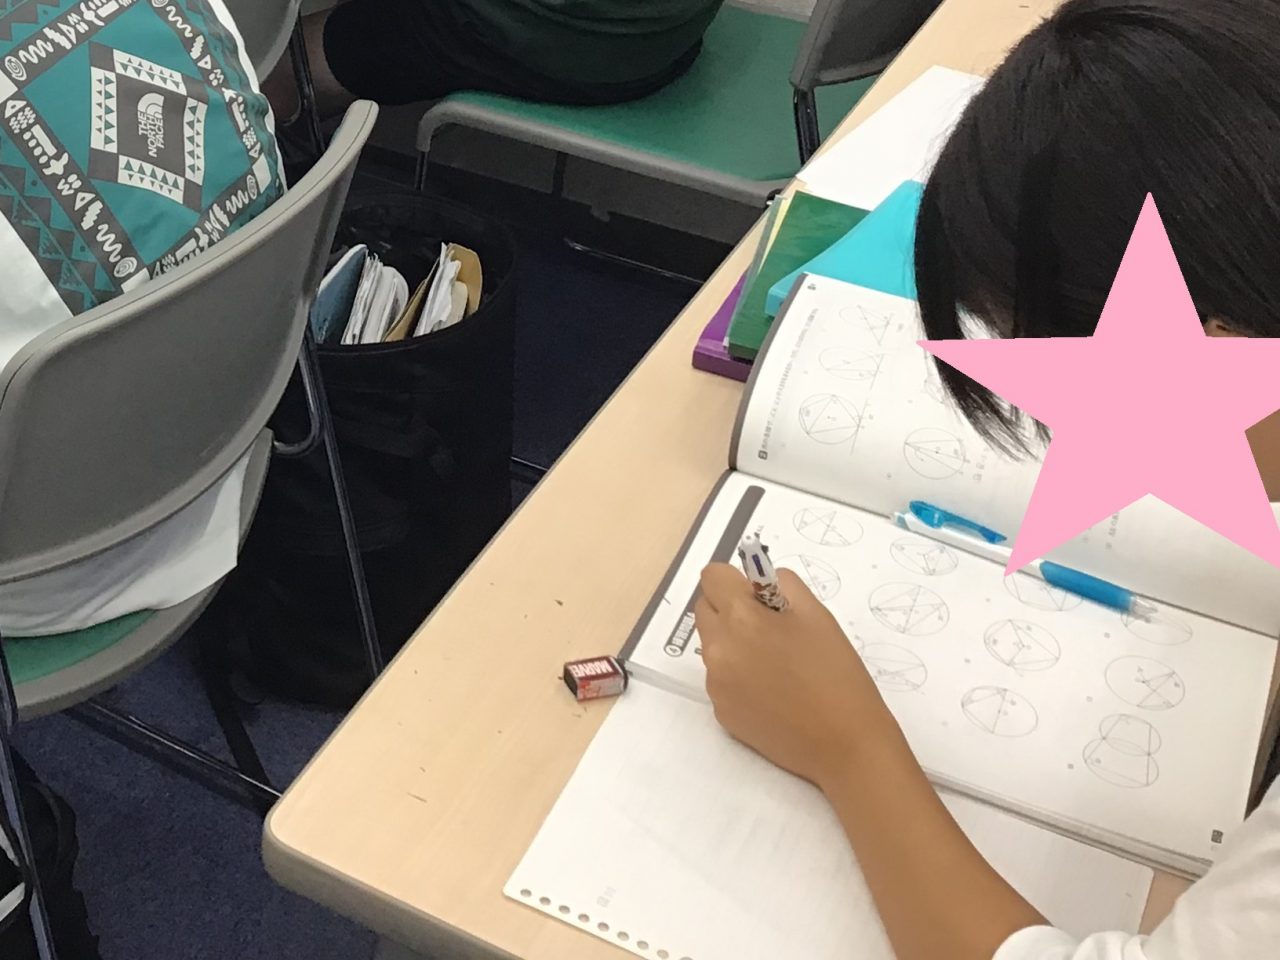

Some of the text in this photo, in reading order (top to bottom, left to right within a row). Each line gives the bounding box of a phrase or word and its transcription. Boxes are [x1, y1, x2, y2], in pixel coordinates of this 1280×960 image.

[138, 111, 147, 135] THE
[147, 113, 158, 158] NORTH
[155, 117, 165, 149] FACE
